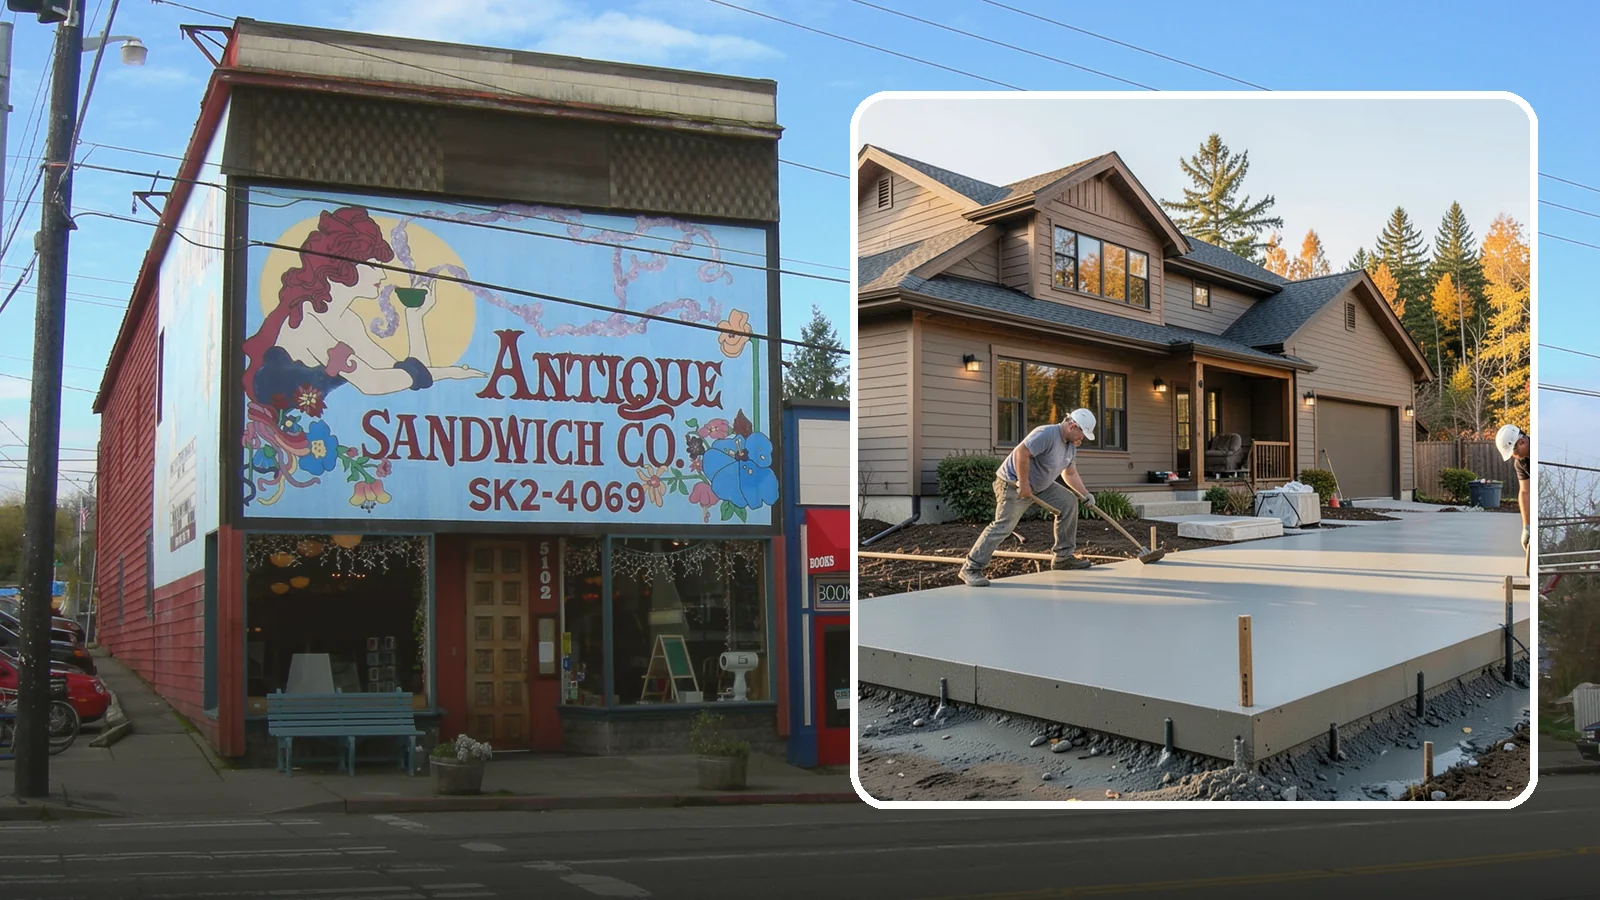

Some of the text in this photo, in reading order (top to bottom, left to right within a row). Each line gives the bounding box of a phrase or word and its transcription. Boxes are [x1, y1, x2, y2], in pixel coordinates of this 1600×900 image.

[476, 329, 723, 420] ANTIQUE
[362, 408, 685, 469] SANDWICH CO.
[468, 477, 646, 513] SK2-4069
[539, 541, 552, 600] 5102
[809, 555, 835, 569] BOOKS
